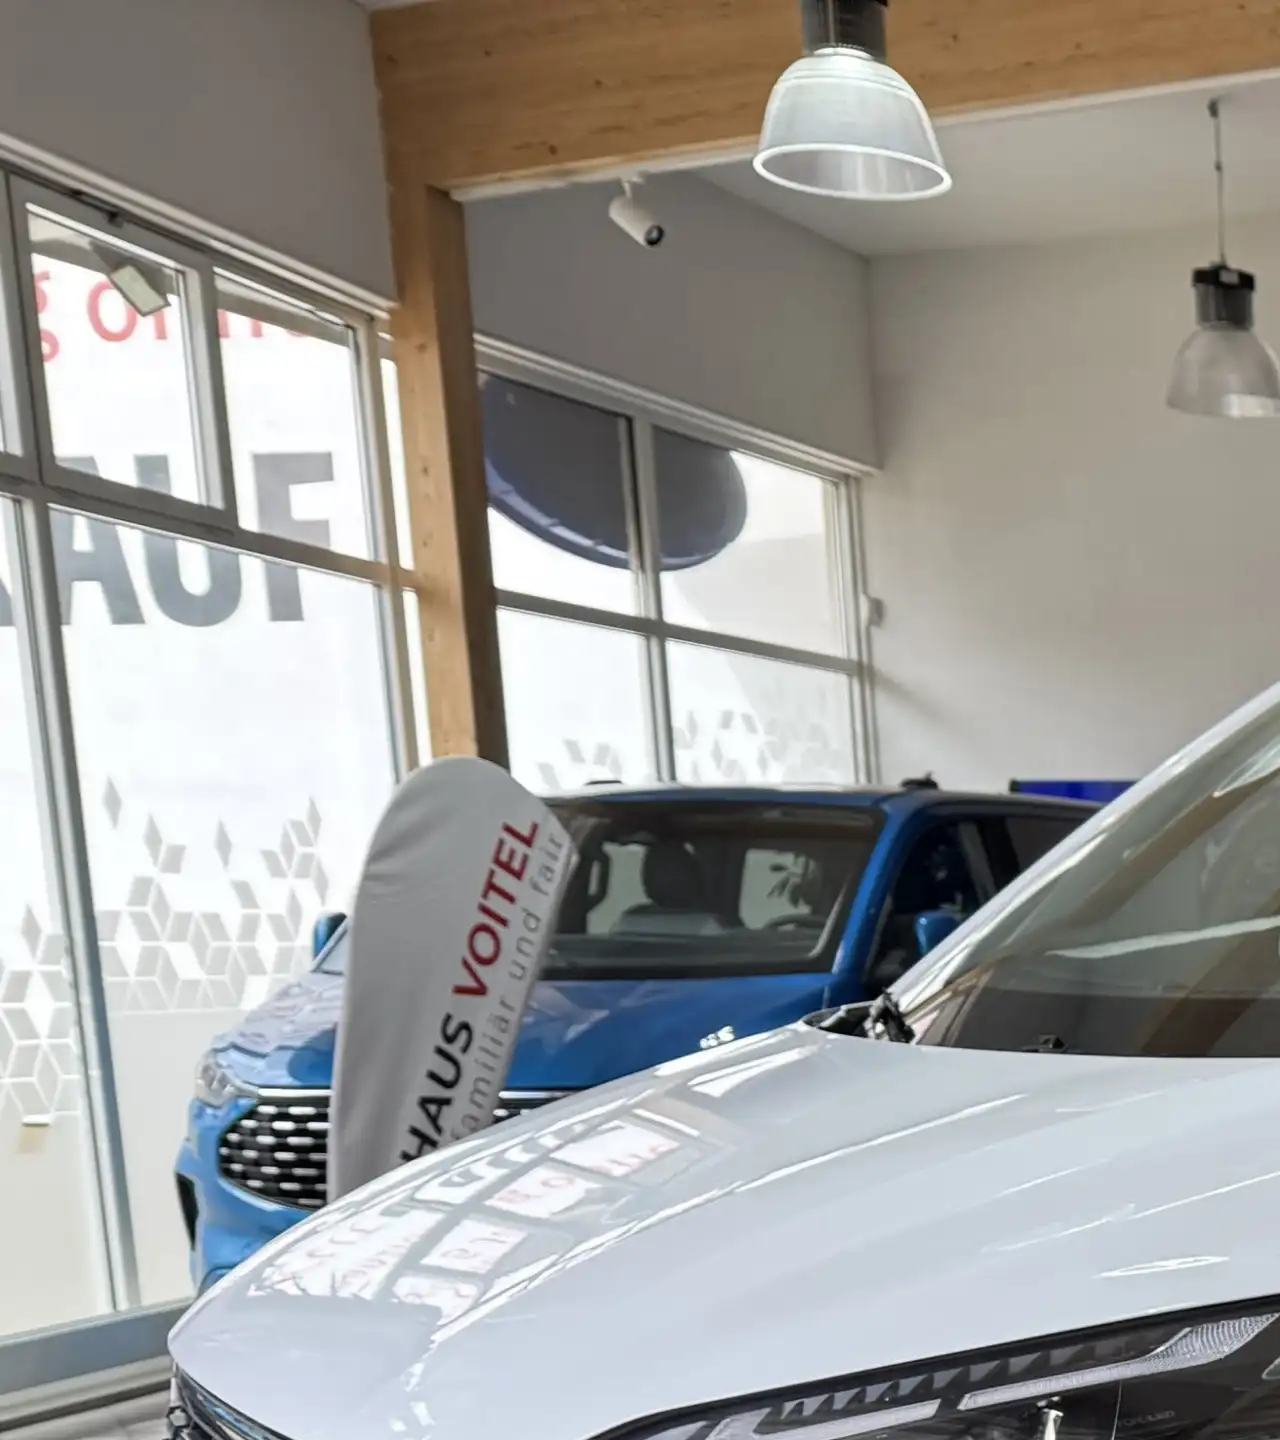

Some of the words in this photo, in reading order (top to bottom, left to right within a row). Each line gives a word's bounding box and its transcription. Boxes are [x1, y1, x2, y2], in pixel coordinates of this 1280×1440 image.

[0, 451, 335, 628] AUF
[453, 821, 540, 998] VOITEL
[508, 907, 543, 982] und
[528, 832, 564, 896] fair
